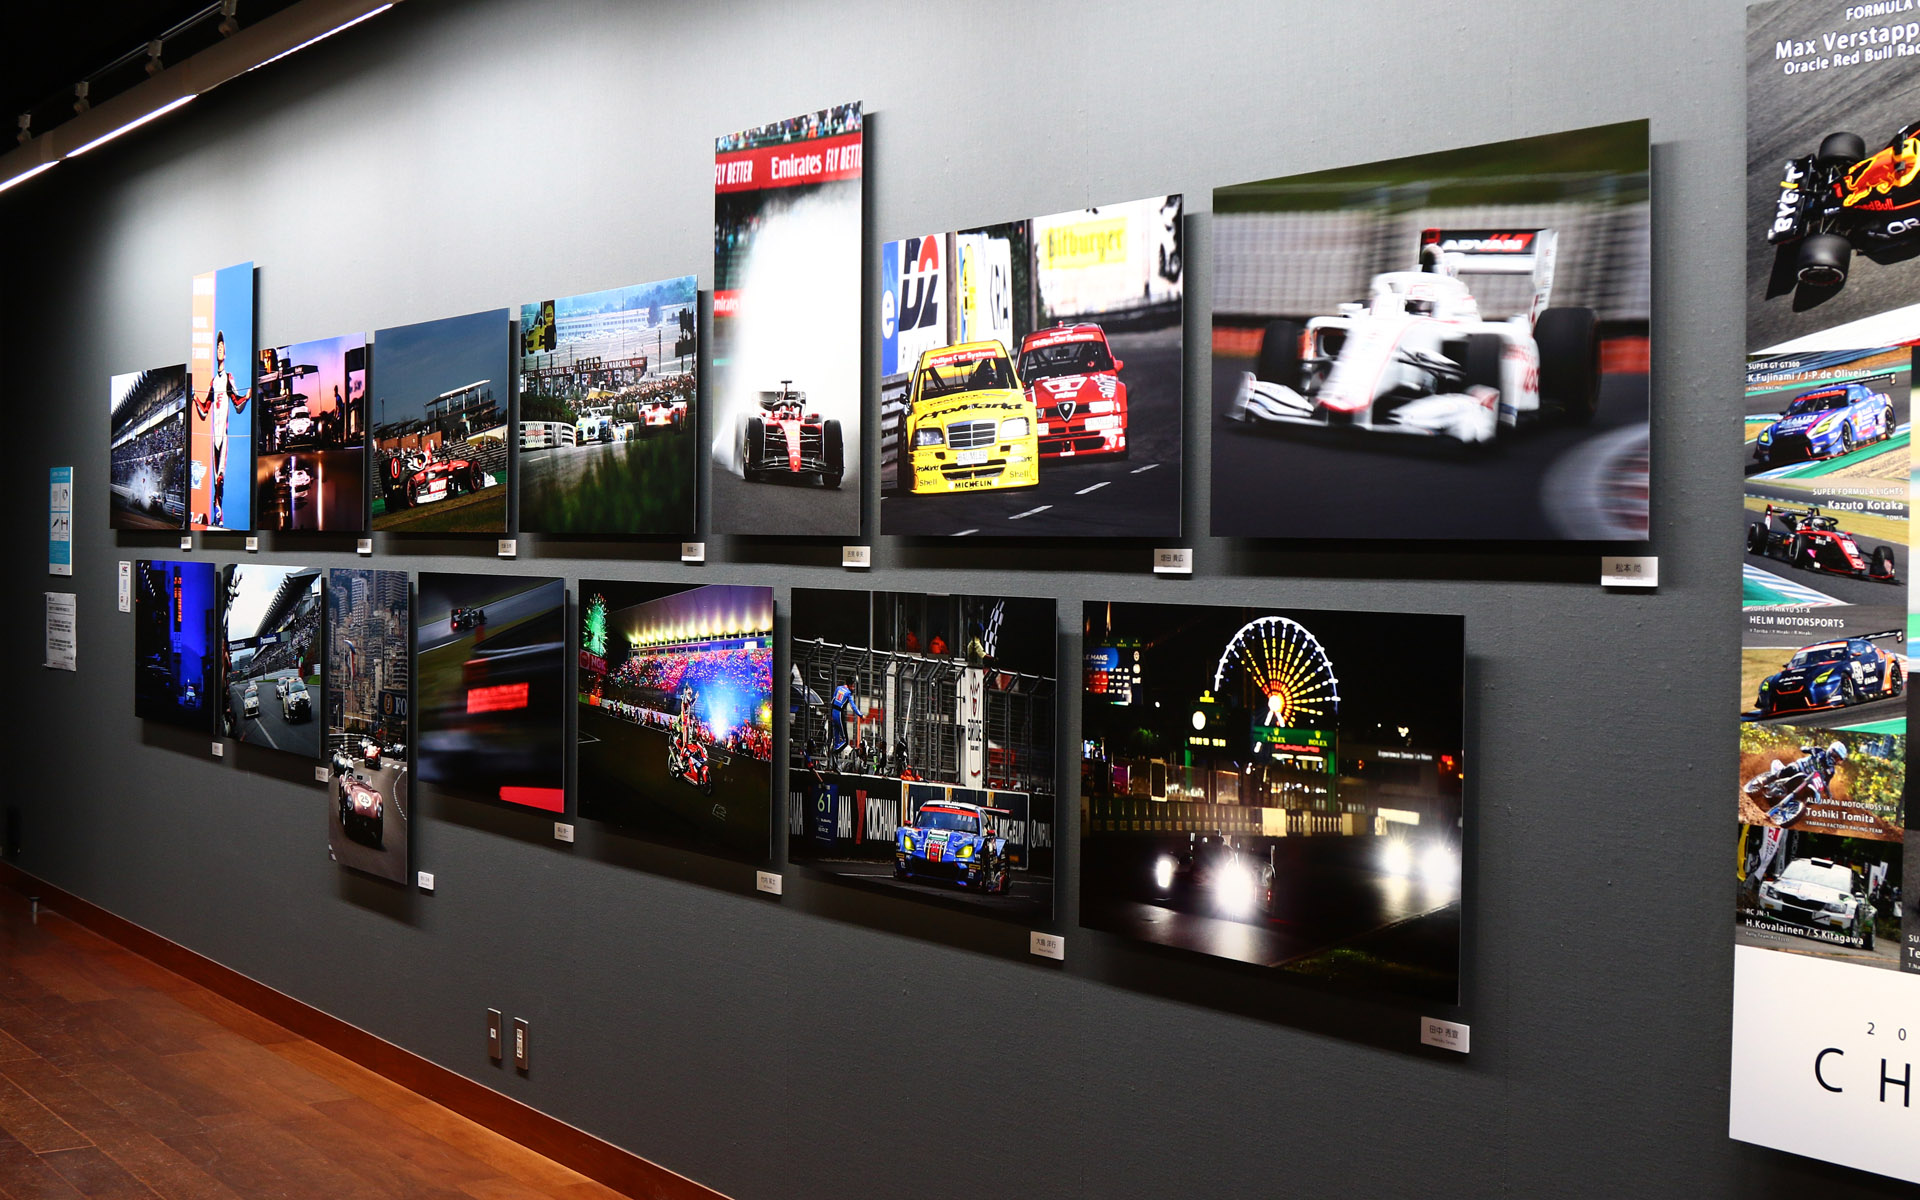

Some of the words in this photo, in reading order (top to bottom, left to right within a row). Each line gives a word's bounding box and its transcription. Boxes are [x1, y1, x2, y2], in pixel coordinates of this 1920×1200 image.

[1846, 0, 1913, 20] FORMULA
[1776, 40, 1816, 60] Max
[1823, 22, 1920, 51] Verstapp
[1784, 57, 1829, 75] Oracle
[1833, 50, 1860, 67] Red
[1865, 45, 1892, 62] Bull
[771, 153, 821, 180] Emirates
[826, 149, 840, 173] FLY
[727, 160, 753, 184] BETTER
[1875, 198, 1895, 211] Bull
[1442, 238, 1524, 250] ADVAN
[1748, 372, 1794, 383] K.Fujinami
[1834, 368, 1872, 378] Oliveira
[1009, 470, 1029, 478] Shell
[919, 479, 938, 487] Shell
[955, 480, 992, 488] MICHELIN
[1876, 487, 1903, 495] LIGHTS
[1827, 500, 1864, 510] Kazuto
[1867, 500, 1903, 510] Kotaka
[1749, 616, 1774, 625] HELM
[1777, 617, 1845, 628] MOTORSPORTS
[817, 792, 831, 814] 61
[1805, 807, 1839, 819] Toshiki
[1842, 811, 1874, 824] Tomita
[1746, 908, 1755, 916] RC
[1746, 918, 1804, 936] H.Kovalainen
[1813, 930, 1864, 945] S.Kitagawa
